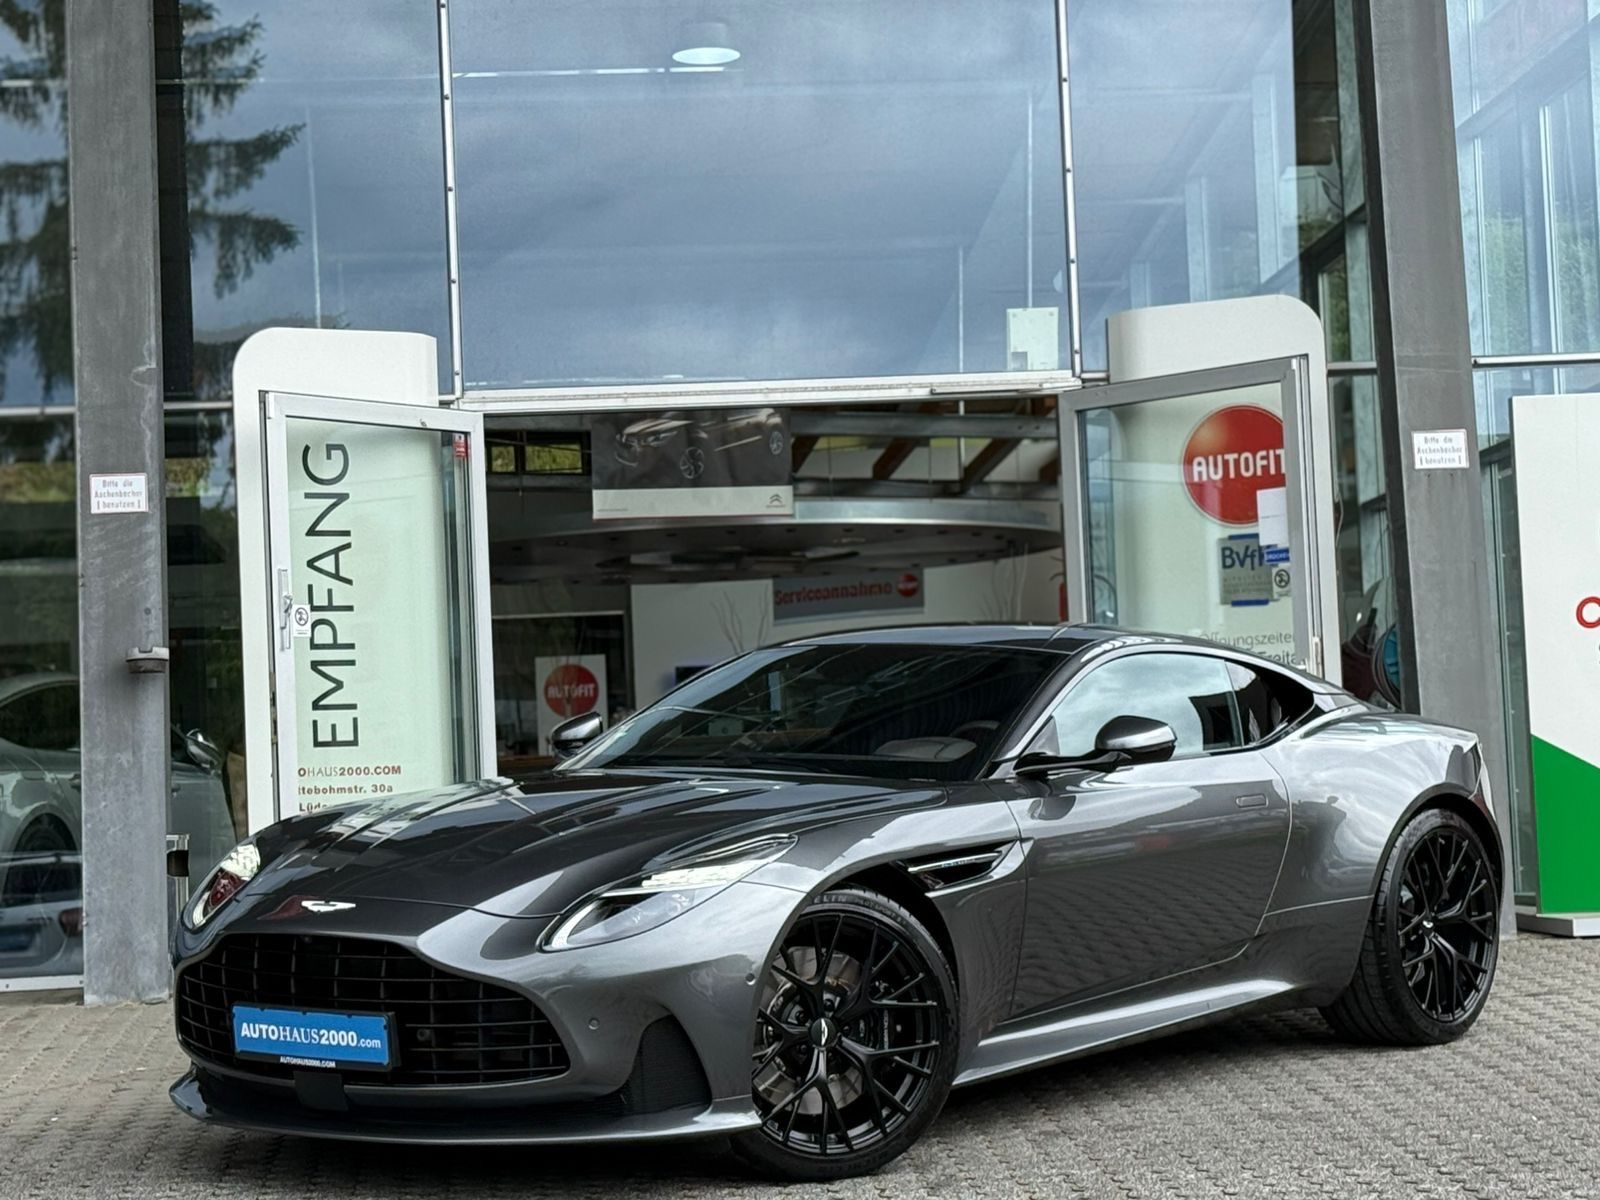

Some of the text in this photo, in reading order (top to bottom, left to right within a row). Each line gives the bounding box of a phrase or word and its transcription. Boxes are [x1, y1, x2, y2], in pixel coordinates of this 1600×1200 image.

[1192, 448, 1286, 482] AUTOFIT
[302, 442, 359, 748] EMPFANG
[547, 683, 595, 699] AUTOFIT
[371, 783, 393, 793] 30a
[241, 1022, 381, 1048] AUTOHAUS2000.com
[280, 1055, 336, 1068] AUTOHAUS2000.COM
